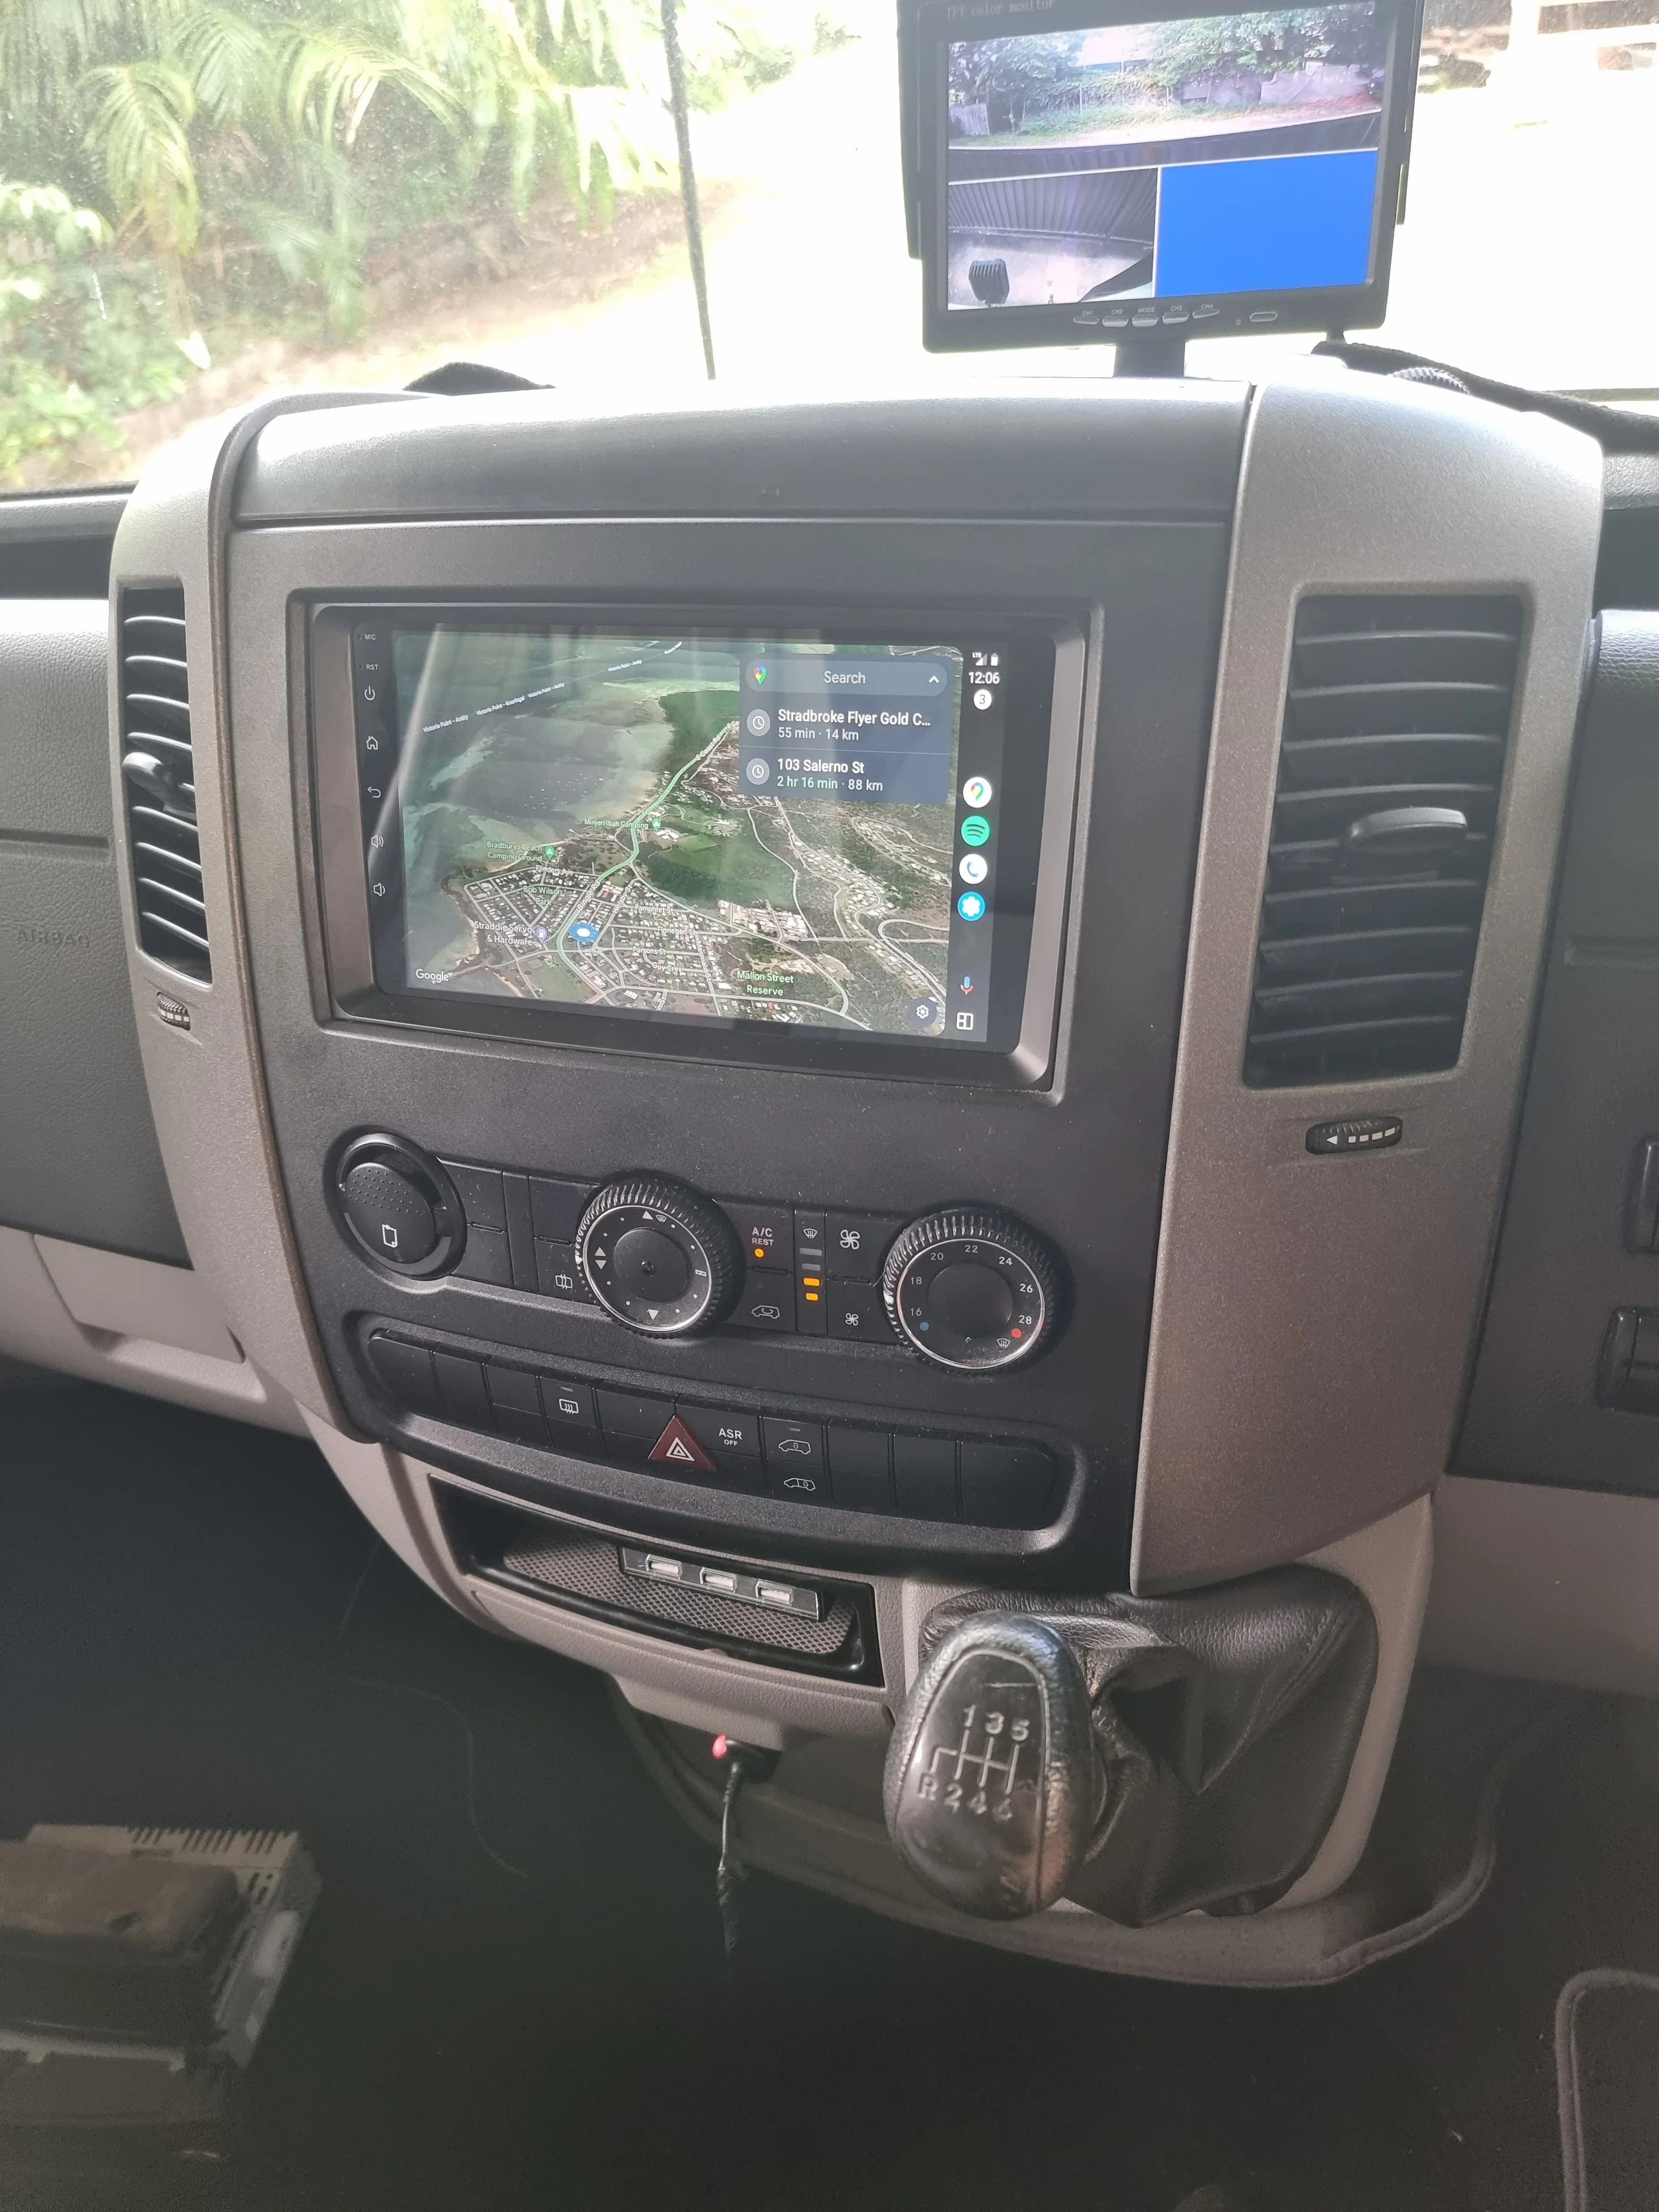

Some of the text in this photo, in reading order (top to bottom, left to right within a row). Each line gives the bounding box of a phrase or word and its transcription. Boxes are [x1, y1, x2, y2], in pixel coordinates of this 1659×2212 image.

[823, 671, 866, 685] Search
[968, 671, 1000, 684] 12:06
[979, 694, 986, 705] 3
[778, 709, 845, 724] Stradbroke
[848, 711, 878, 727] Flyer
[881, 712, 909, 726] Gold
[778, 727, 792, 739] 55
[795, 728, 815, 739] min
[826, 728, 839, 739] 14
[842, 729, 859, 740] km
[700, 743, 715, 758] Coast
[712, 734, 721, 744] Rd
[777, 758, 864, 774] 103 Salerno St
[777, 776, 784, 787] 2
[786, 776, 798, 787] hr
[801, 777, 815, 789] 16
[817, 778, 838, 790] min
[848, 779, 863, 790] 88
[866, 780, 883, 791] km
[584, 818, 649, 830] Minjerribah Camping
[487, 841, 542, 852] Bradburys Beach
[488, 852, 542, 862] Camping Ground
[536, 865, 560, 874] Flinders
[537, 886, 562, 895] Wilson
[577, 880, 601, 911] Bingle Rd
[612, 884, 633, 914] Welsby St
[635, 904, 666, 914] Pamphlet
[474, 921, 533, 934] Straddie Servo
[658, 926, 688, 935] Finnegan
[17, 927, 90, 947] AIRBAG
[487, 935, 533, 947] & Hardware
[633, 946, 658, 955] Parsons
[696, 941, 709, 972] Mermaid
[652, 962, 665, 972] Guy
[415, 968, 450, 983] Google
[737, 971, 794, 983] Mallon Street
[747, 985, 784, 995] Reserve
[752, 1226, 773, 1237] A/C
[752, 1238, 774, 1246] REST
[964, 1244, 978, 1253] 22
[930, 1253, 944, 1261] 20
[999, 1256, 1013, 1266] 24
[910, 1276, 922, 1286] 18
[1020, 1283, 1034, 1293] 26
[910, 1307, 922, 1317] 16
[1019, 1314, 1032, 1325] 28
[718, 1427, 743, 1440] ASR
[963, 1704, 1030, 1741] 1 3 5
[918, 1772, 938, 1801] R
[944, 1782, 963, 1814] 2
[969, 1791, 988, 1815] 4
